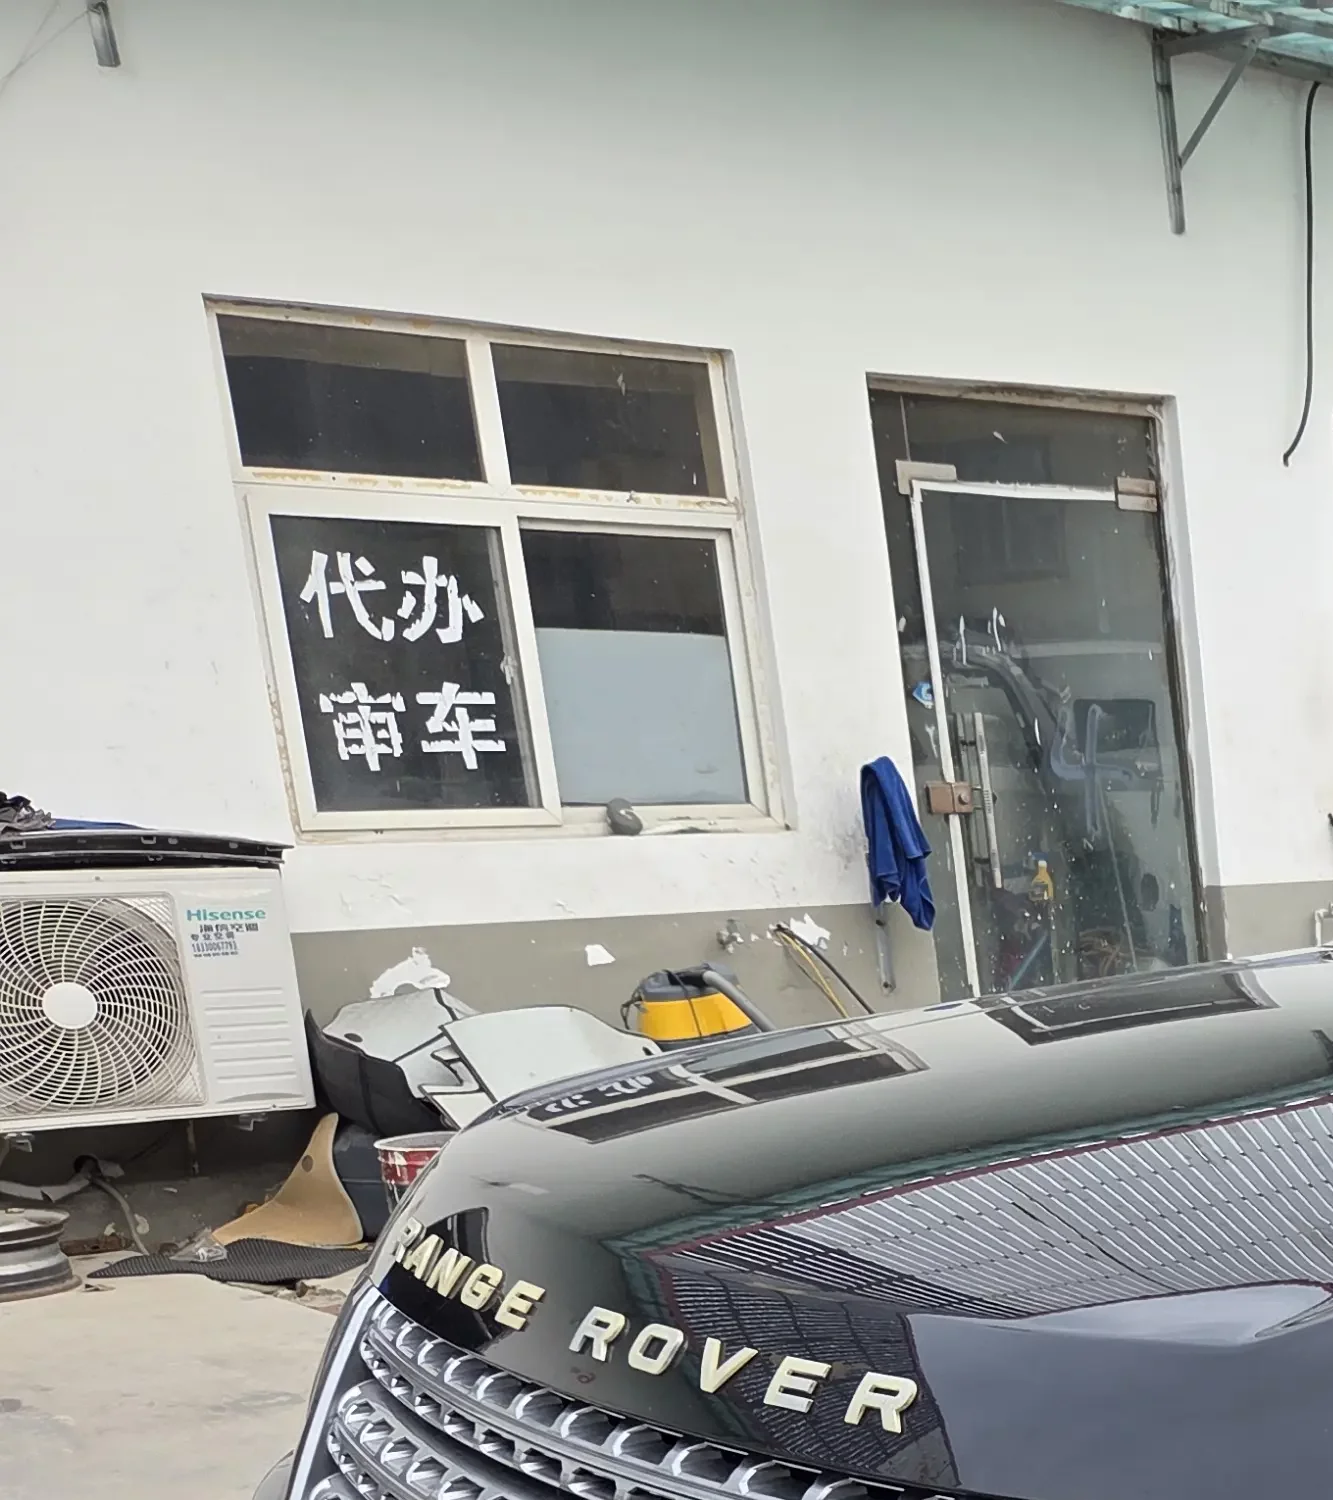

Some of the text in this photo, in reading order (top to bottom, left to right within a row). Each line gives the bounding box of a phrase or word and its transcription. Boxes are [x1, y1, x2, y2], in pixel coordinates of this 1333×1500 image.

[299, 550, 485, 644] 代办
[186, 908, 266, 921] Hisense
[393, 1216, 918, 1434] RANGE ROVER
